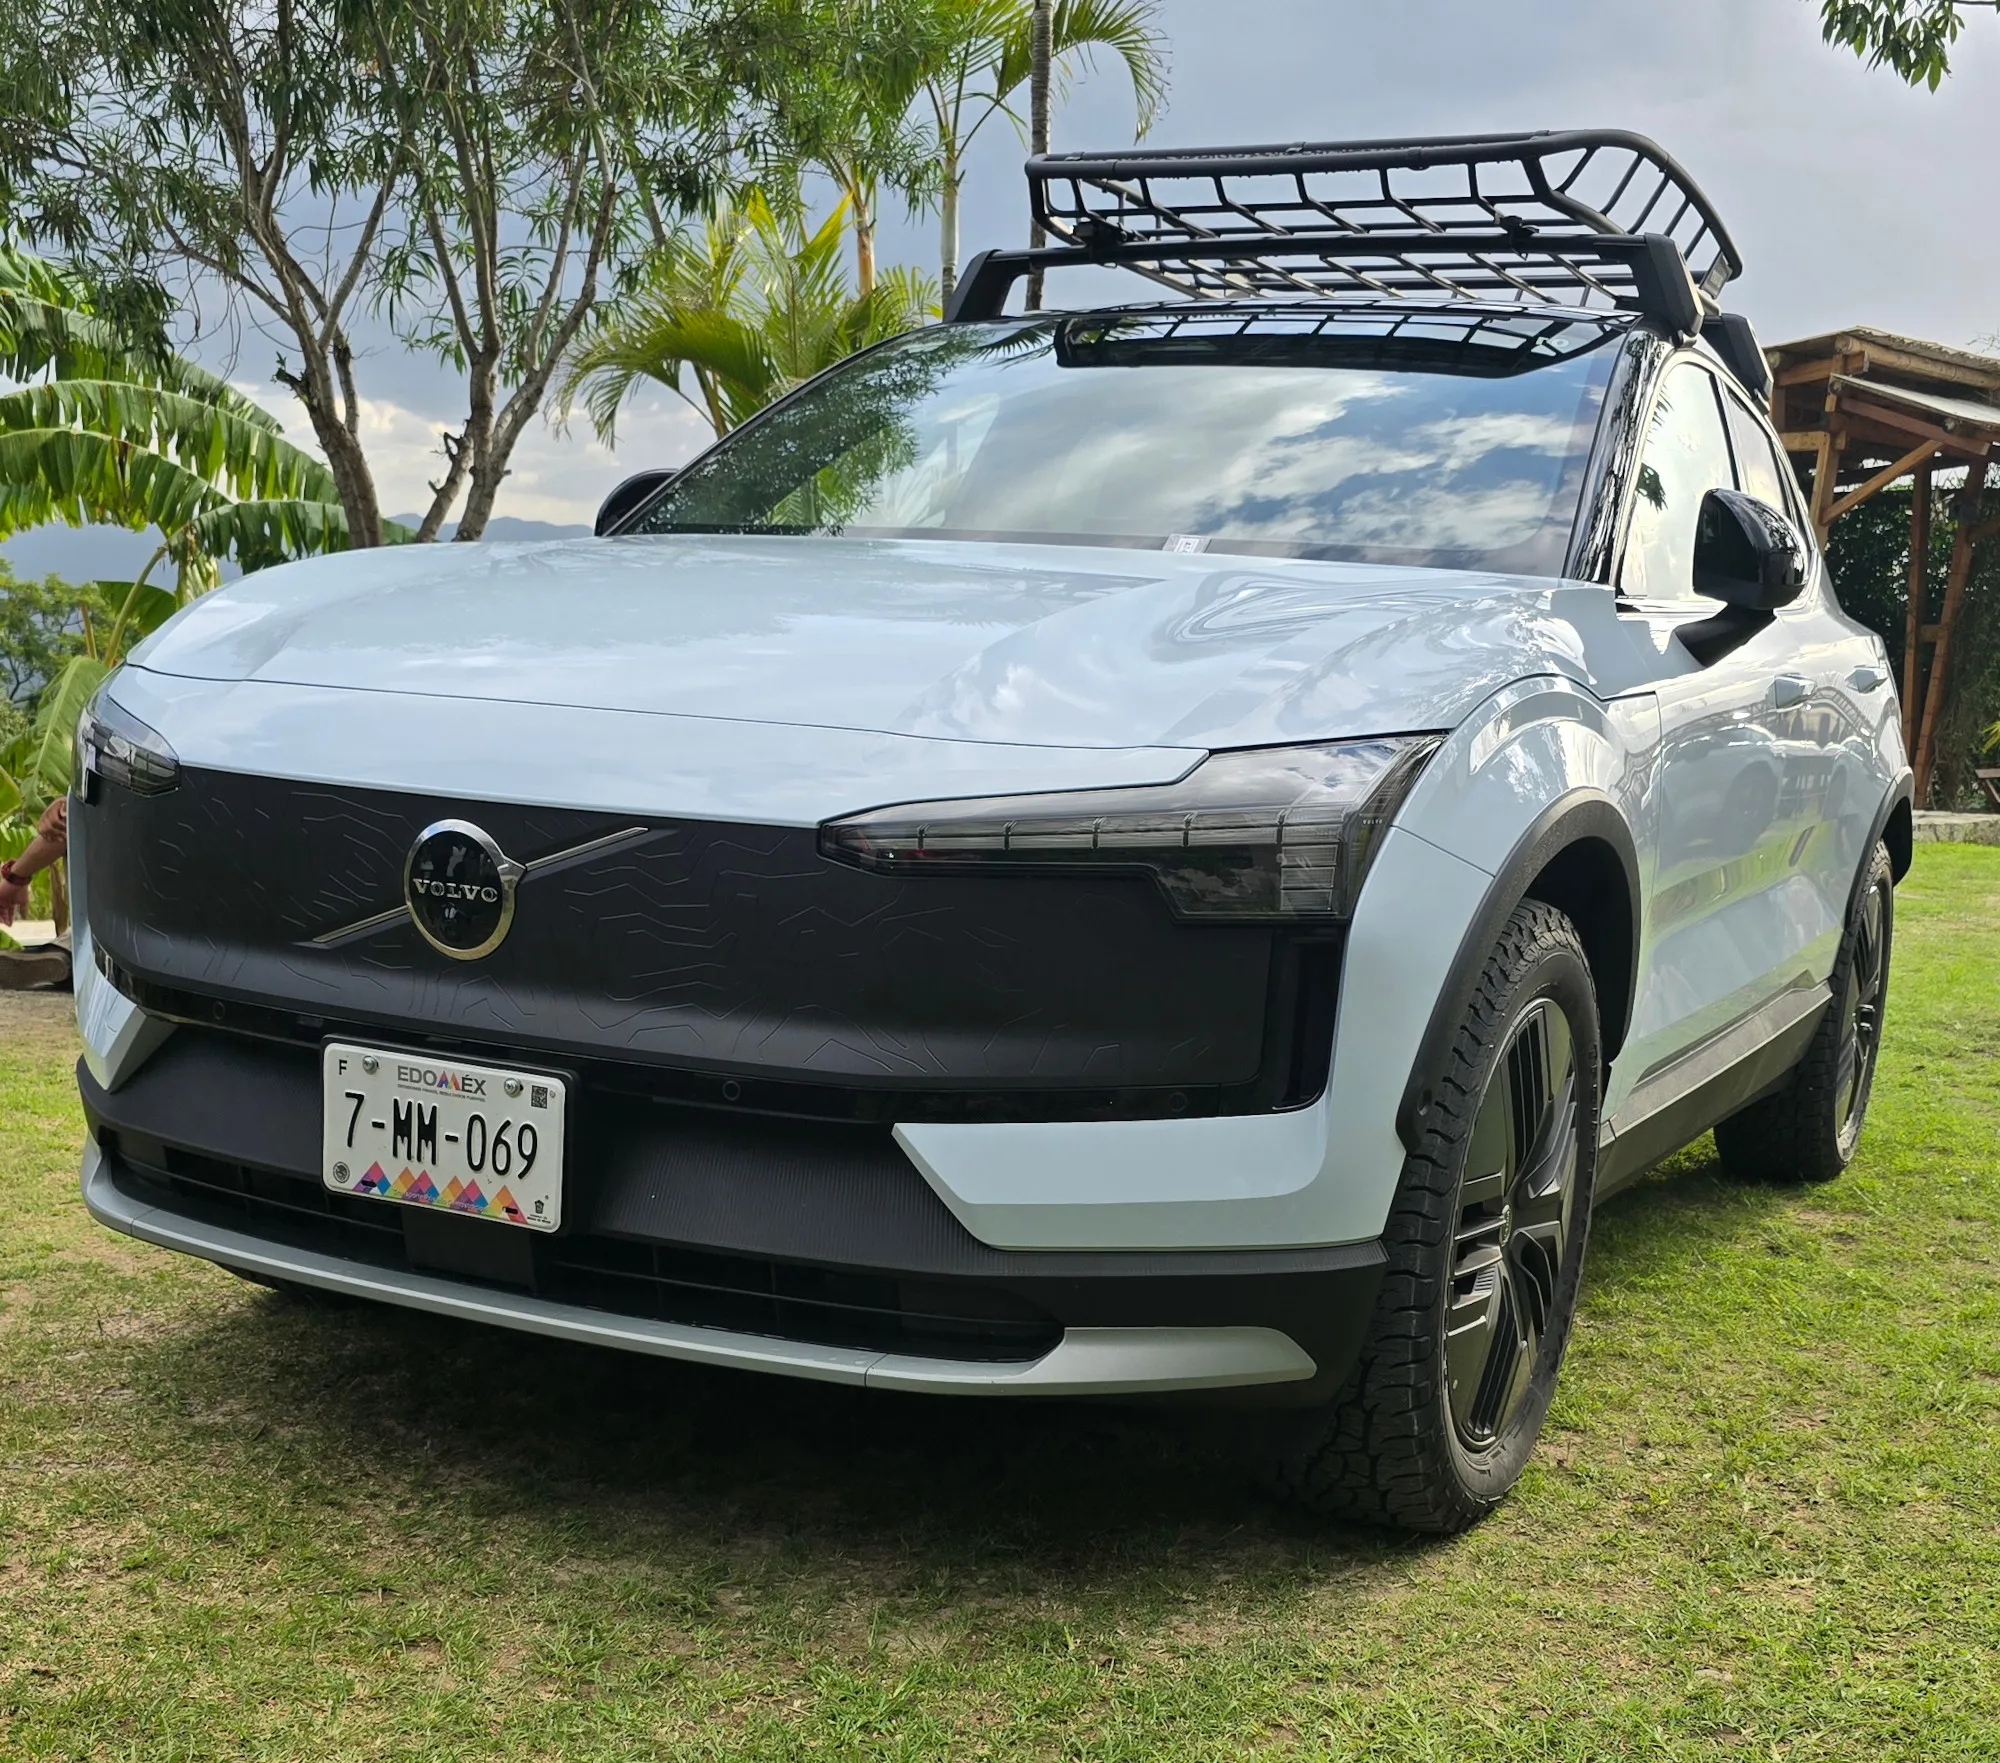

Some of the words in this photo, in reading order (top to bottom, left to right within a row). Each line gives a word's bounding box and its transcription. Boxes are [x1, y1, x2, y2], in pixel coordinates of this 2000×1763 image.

[413, 878, 498, 903] VOLVO
[338, 1059, 348, 1076] F
[345, 1091, 538, 1180] 7-MM-069
